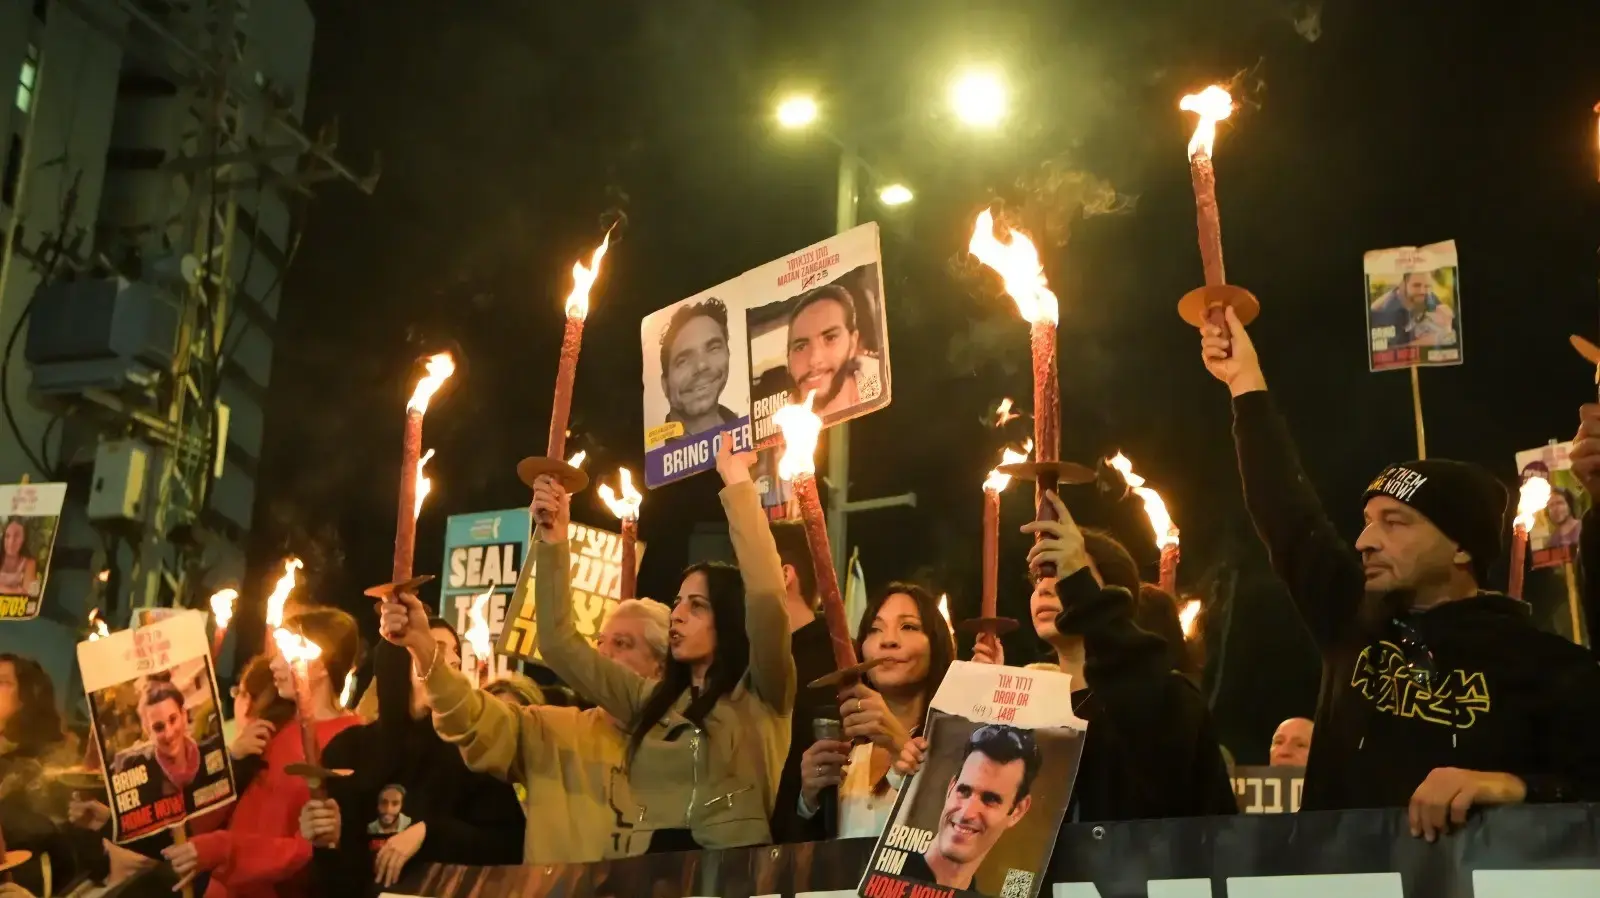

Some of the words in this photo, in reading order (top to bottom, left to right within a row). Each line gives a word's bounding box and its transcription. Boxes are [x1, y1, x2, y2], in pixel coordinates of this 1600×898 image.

[777, 269, 800, 287] MATAN
[801, 253, 840, 277] ZANGAUKER
[753, 390, 788, 419] BRING
[755, 417, 778, 441] HIM
[663, 439, 709, 477] BRING
[712, 424, 753, 457] OER
[1383, 479, 1417, 502] NOW!
[1393, 467, 1428, 486] THEM
[449, 544, 518, 588] SEAL
[454, 593, 507, 637] TE
[461, 640, 512, 677] EL
[999, 674, 1013, 688] אור
[1015, 676, 1034, 691] דרור
[993, 690, 1017, 705] DROR
[1016, 693, 1030, 707] OR
[112, 764, 149, 794] BRING
[116, 788, 142, 814] HER
[121, 804, 154, 832] HOME
[884, 823, 934, 854] BRING
[874, 847, 909, 876] HIM
[864, 874, 911, 898] HOME
